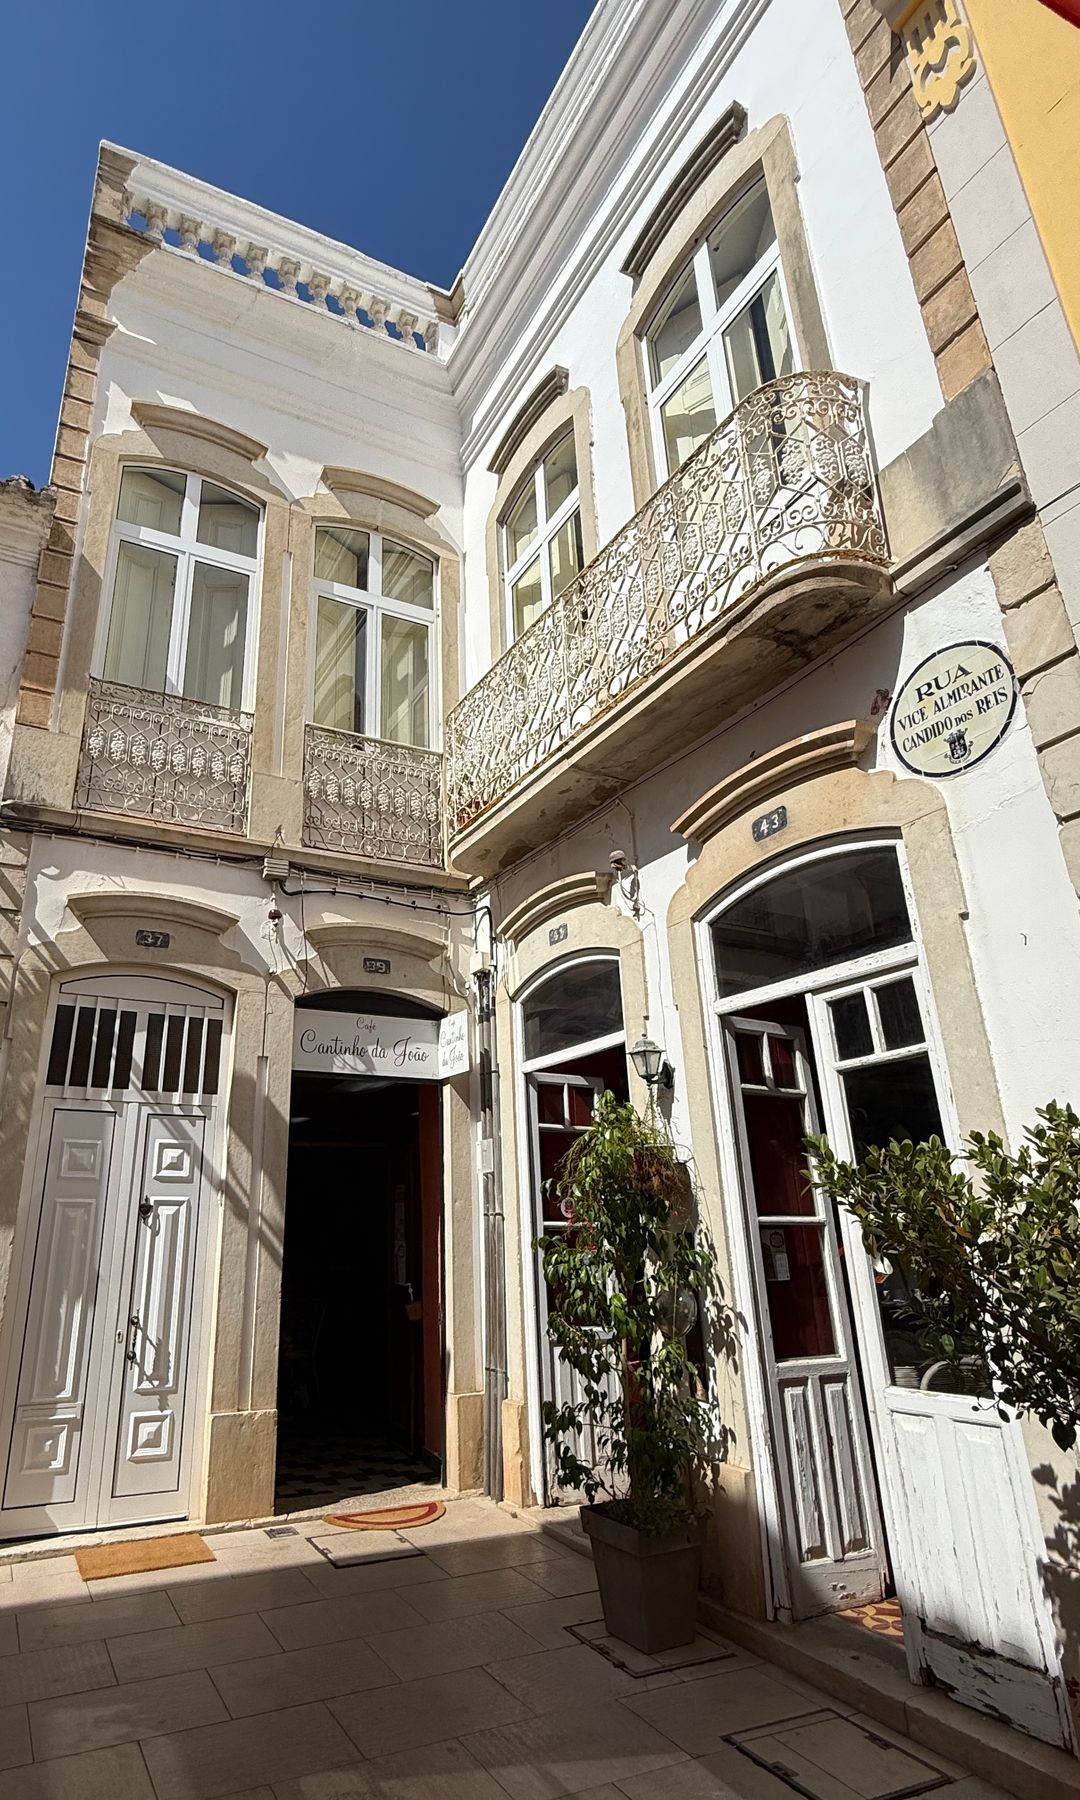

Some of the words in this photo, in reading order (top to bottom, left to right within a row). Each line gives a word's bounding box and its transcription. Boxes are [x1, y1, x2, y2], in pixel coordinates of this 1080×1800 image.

[897, 706, 928, 731] VICE
[933, 664, 1005, 714] ALMIRANTE
[915, 664, 973, 702] RUA
[902, 716, 953, 752] CANDIDO
[976, 686, 1008, 715] REIS
[760, 813, 779, 836] 43
[143, 931, 163, 945] 37
[356, 1016, 376, 1033] Café
[300, 1028, 368, 1058] Cantinho
[371, 1037, 388, 1059] da
[393, 1036, 429, 1067] João
